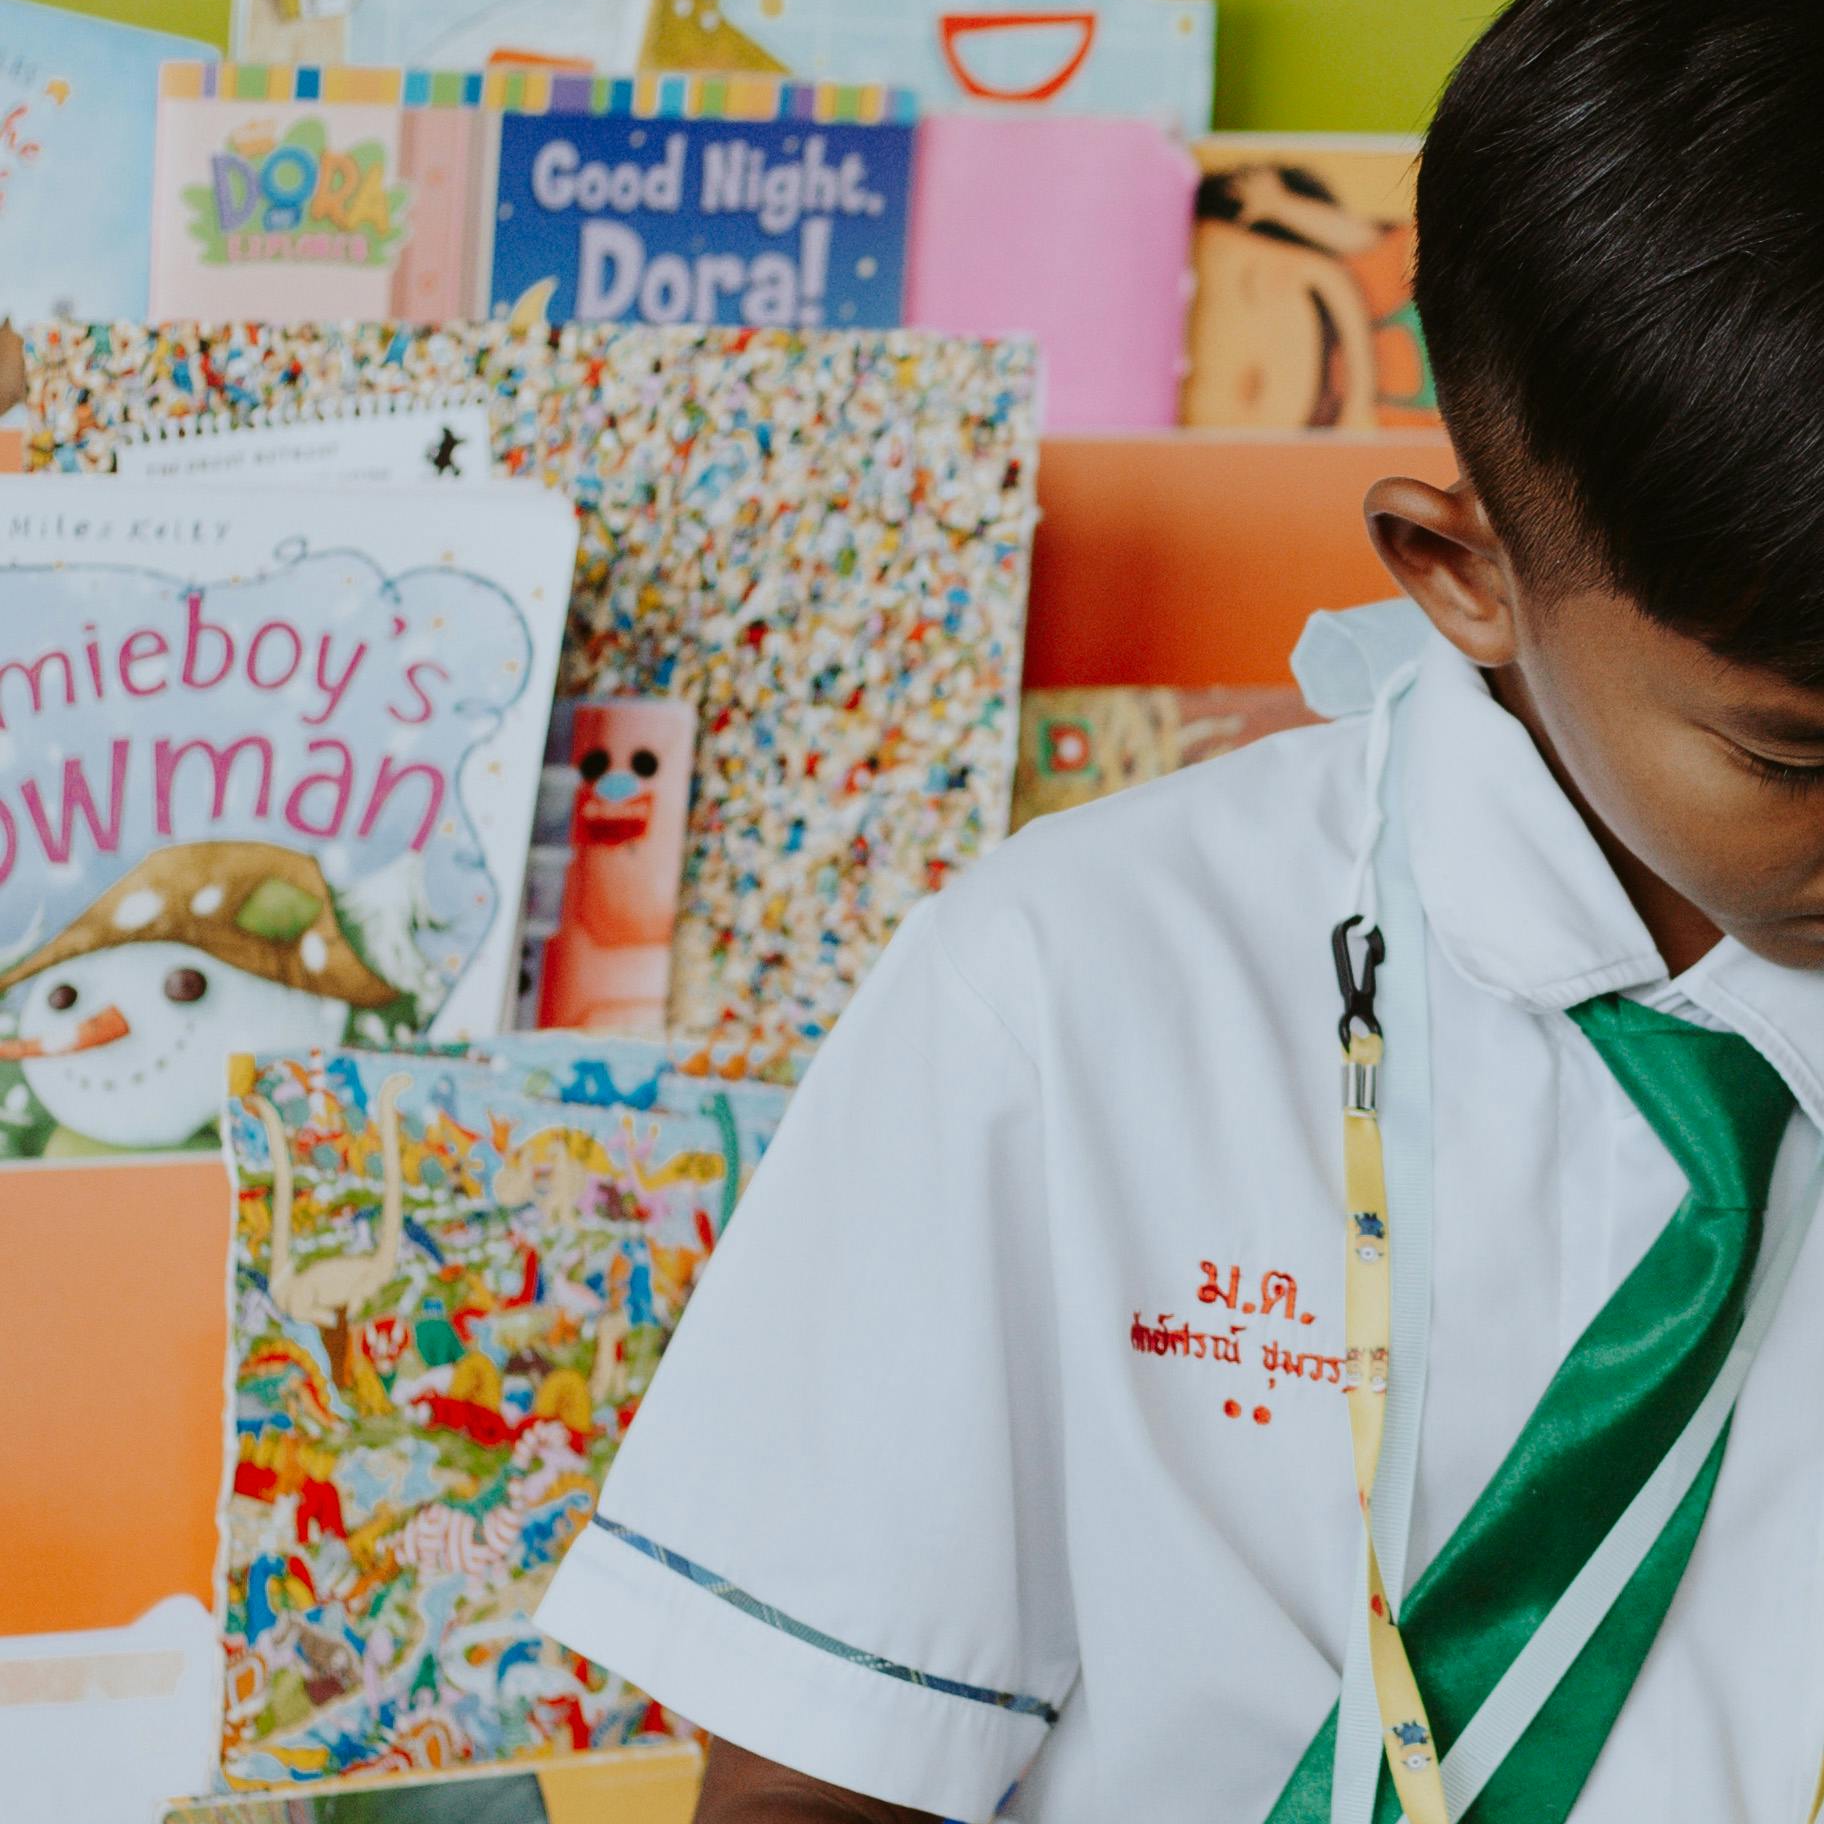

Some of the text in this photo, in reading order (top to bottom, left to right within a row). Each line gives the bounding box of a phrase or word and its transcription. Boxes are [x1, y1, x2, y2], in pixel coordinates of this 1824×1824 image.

[211, 144, 391, 240] DORA
[532, 133, 689, 212] Good
[575, 216, 833, 325] Dora!
[0, 736, 446, 885] wman
